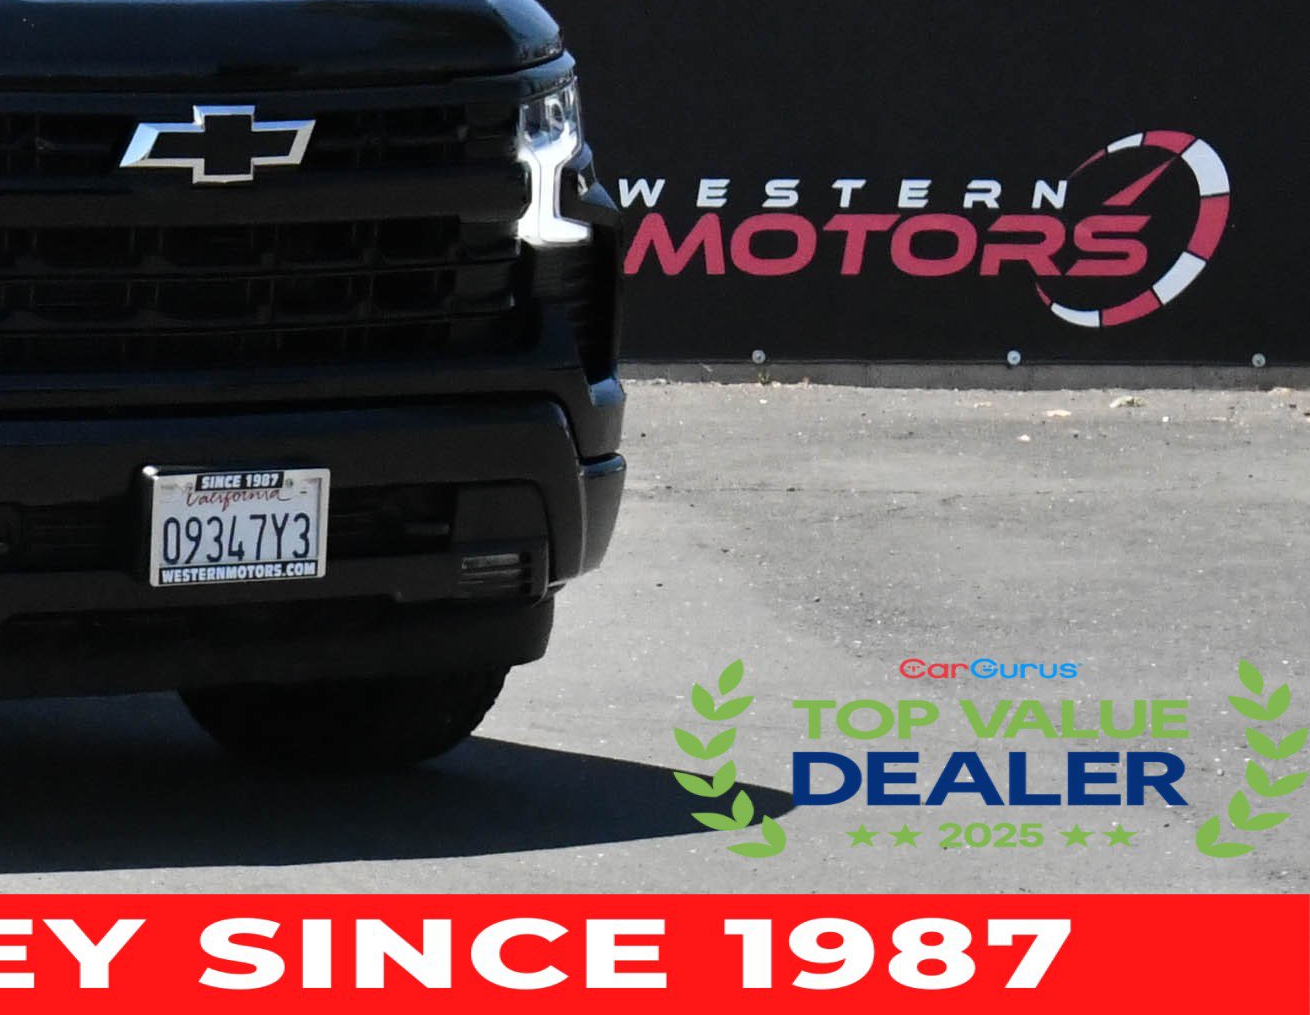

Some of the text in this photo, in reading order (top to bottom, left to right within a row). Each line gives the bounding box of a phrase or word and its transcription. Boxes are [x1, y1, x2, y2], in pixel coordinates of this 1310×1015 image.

[618, 178, 1068, 209] WESTERN
[623, 212, 1151, 277] MOTORS
[201, 474, 279, 489] SINCE 1987
[162, 512, 311, 565] 09347Y3
[162, 562, 316, 583] WESTERNMOTORS.COM
